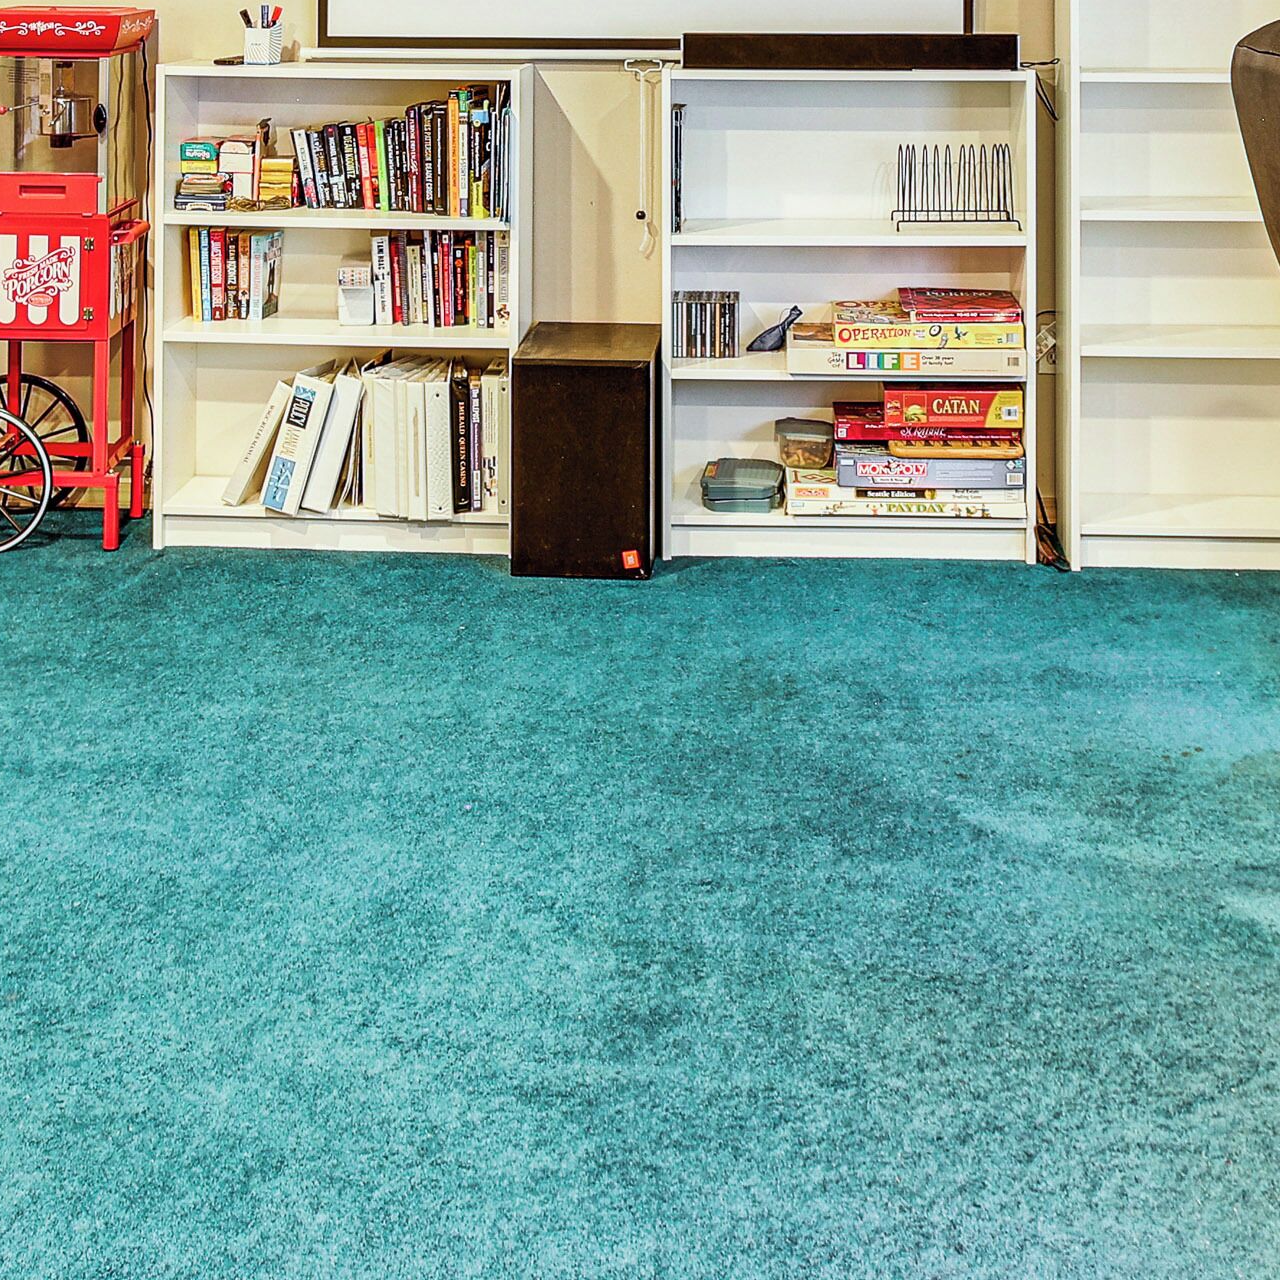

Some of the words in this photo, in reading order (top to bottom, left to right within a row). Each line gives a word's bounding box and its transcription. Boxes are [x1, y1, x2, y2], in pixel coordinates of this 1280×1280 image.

[424, 116, 433, 131] JAMES
[328, 137, 336, 157] MICHAEL
[343, 135, 354, 153] DEAN
[424, 131, 433, 161] PATTERSON
[345, 153, 356, 179] KOONTZ
[425, 163, 433, 182] DEADLY
[425, 183, 433, 200] CROSS
[211, 241, 222, 257] JAMES
[228, 244, 236, 260] DEAN
[40, 255, 59, 269] MADE
[377, 255, 385, 270] HOAG
[499, 248, 508, 275] WOMEN'S
[3, 257, 73, 301] POPCORN
[211, 257, 222, 284] PATTERSON
[227, 260, 237, 284] KOONTZ
[499, 276, 508, 302] HEALTH
[838, 327, 912, 343] OPERATION
[847, 353, 919, 370] LIFE
[472, 389, 480, 398] The
[289, 398, 310, 426] POLICY
[932, 399, 981, 414] CATAN
[280, 426, 300, 457] MANUAL
[859, 464, 925, 476] MONOPOLY
[891, 489, 916, 498] Edition
[886, 503, 916, 513] PAY
[917, 503, 947, 513] DAY
